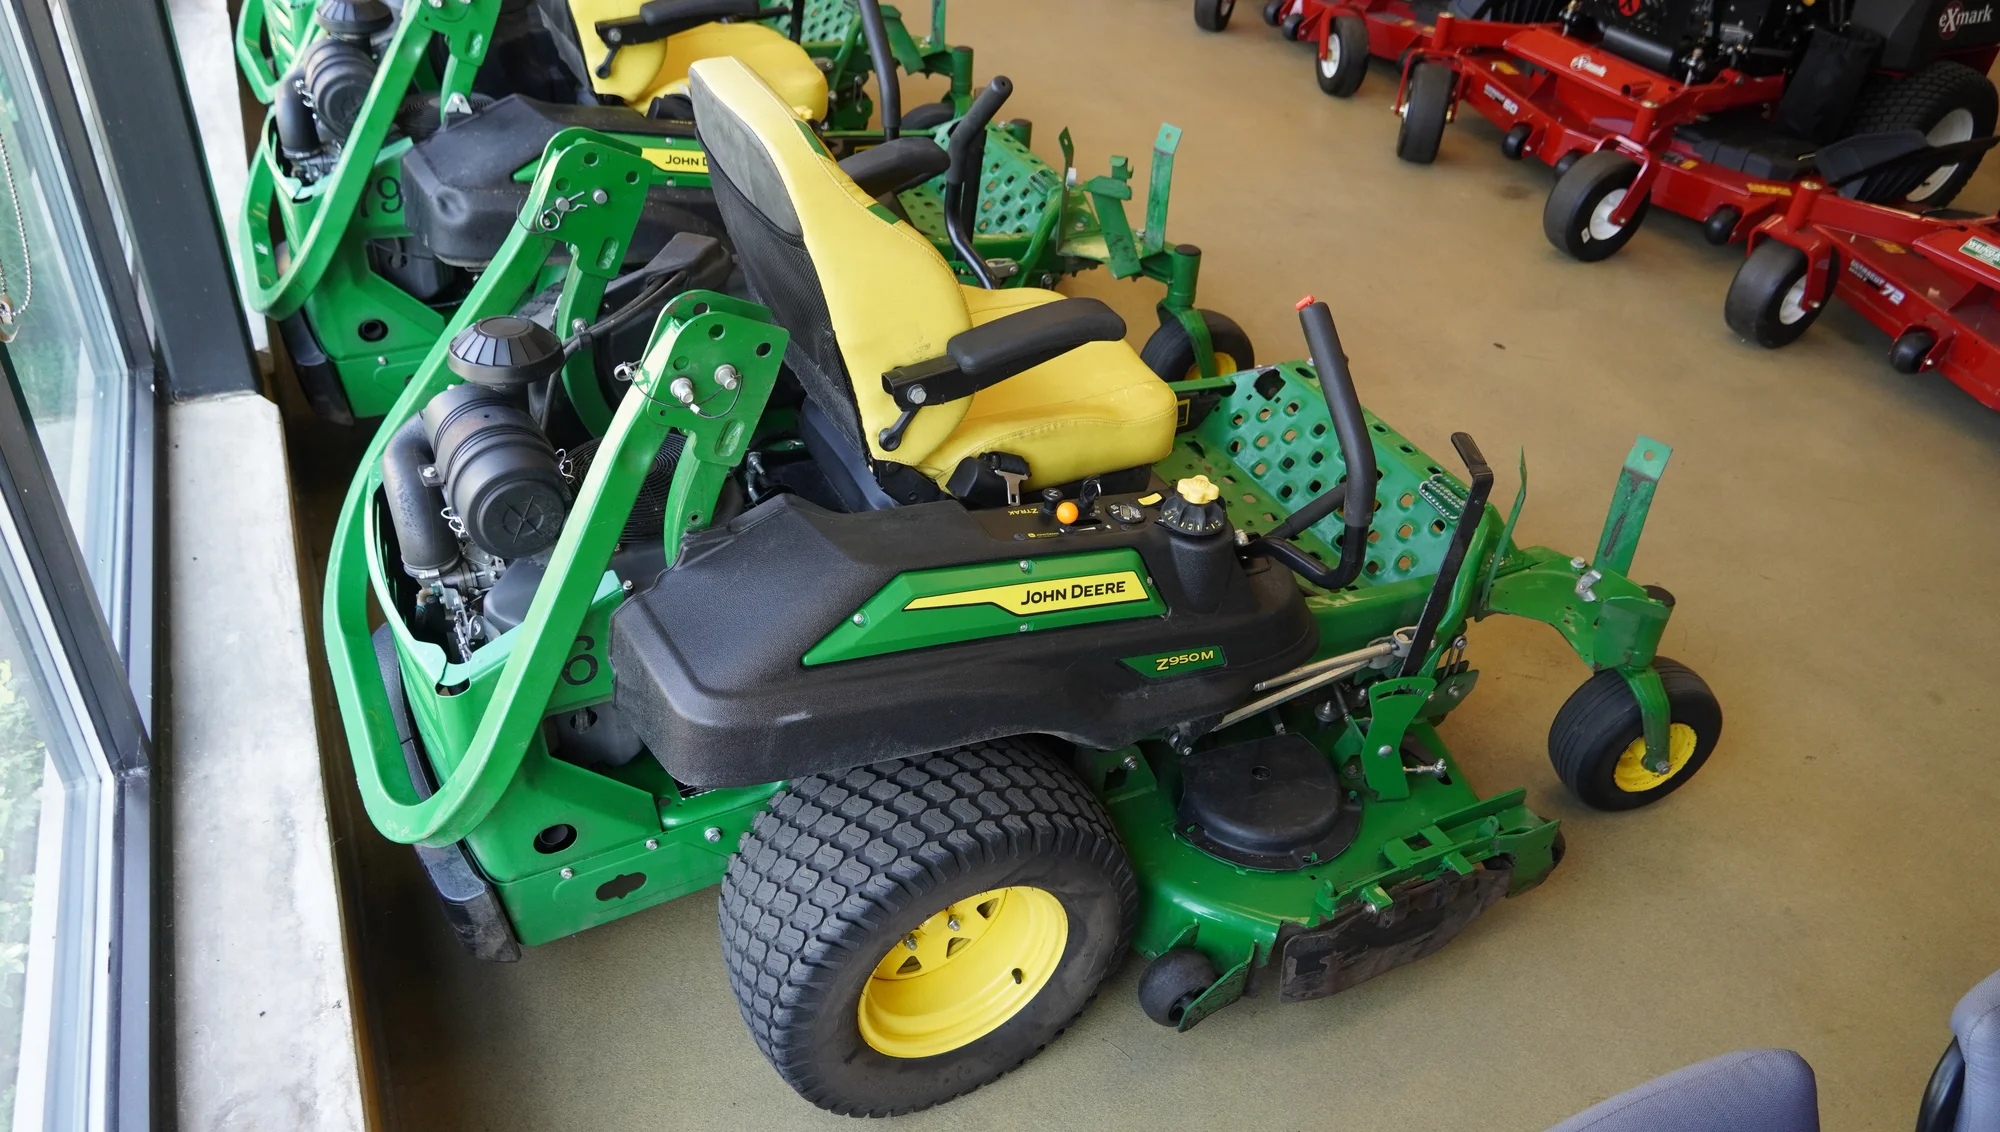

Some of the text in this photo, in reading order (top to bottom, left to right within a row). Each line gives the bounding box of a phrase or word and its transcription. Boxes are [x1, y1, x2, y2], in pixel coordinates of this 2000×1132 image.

[665, 155, 699, 166] JOHN
[1881, 282, 1905, 306] 72
[1020, 581, 1126, 606] JOHN DEERE
[1156, 650, 1214, 672] Z950M
